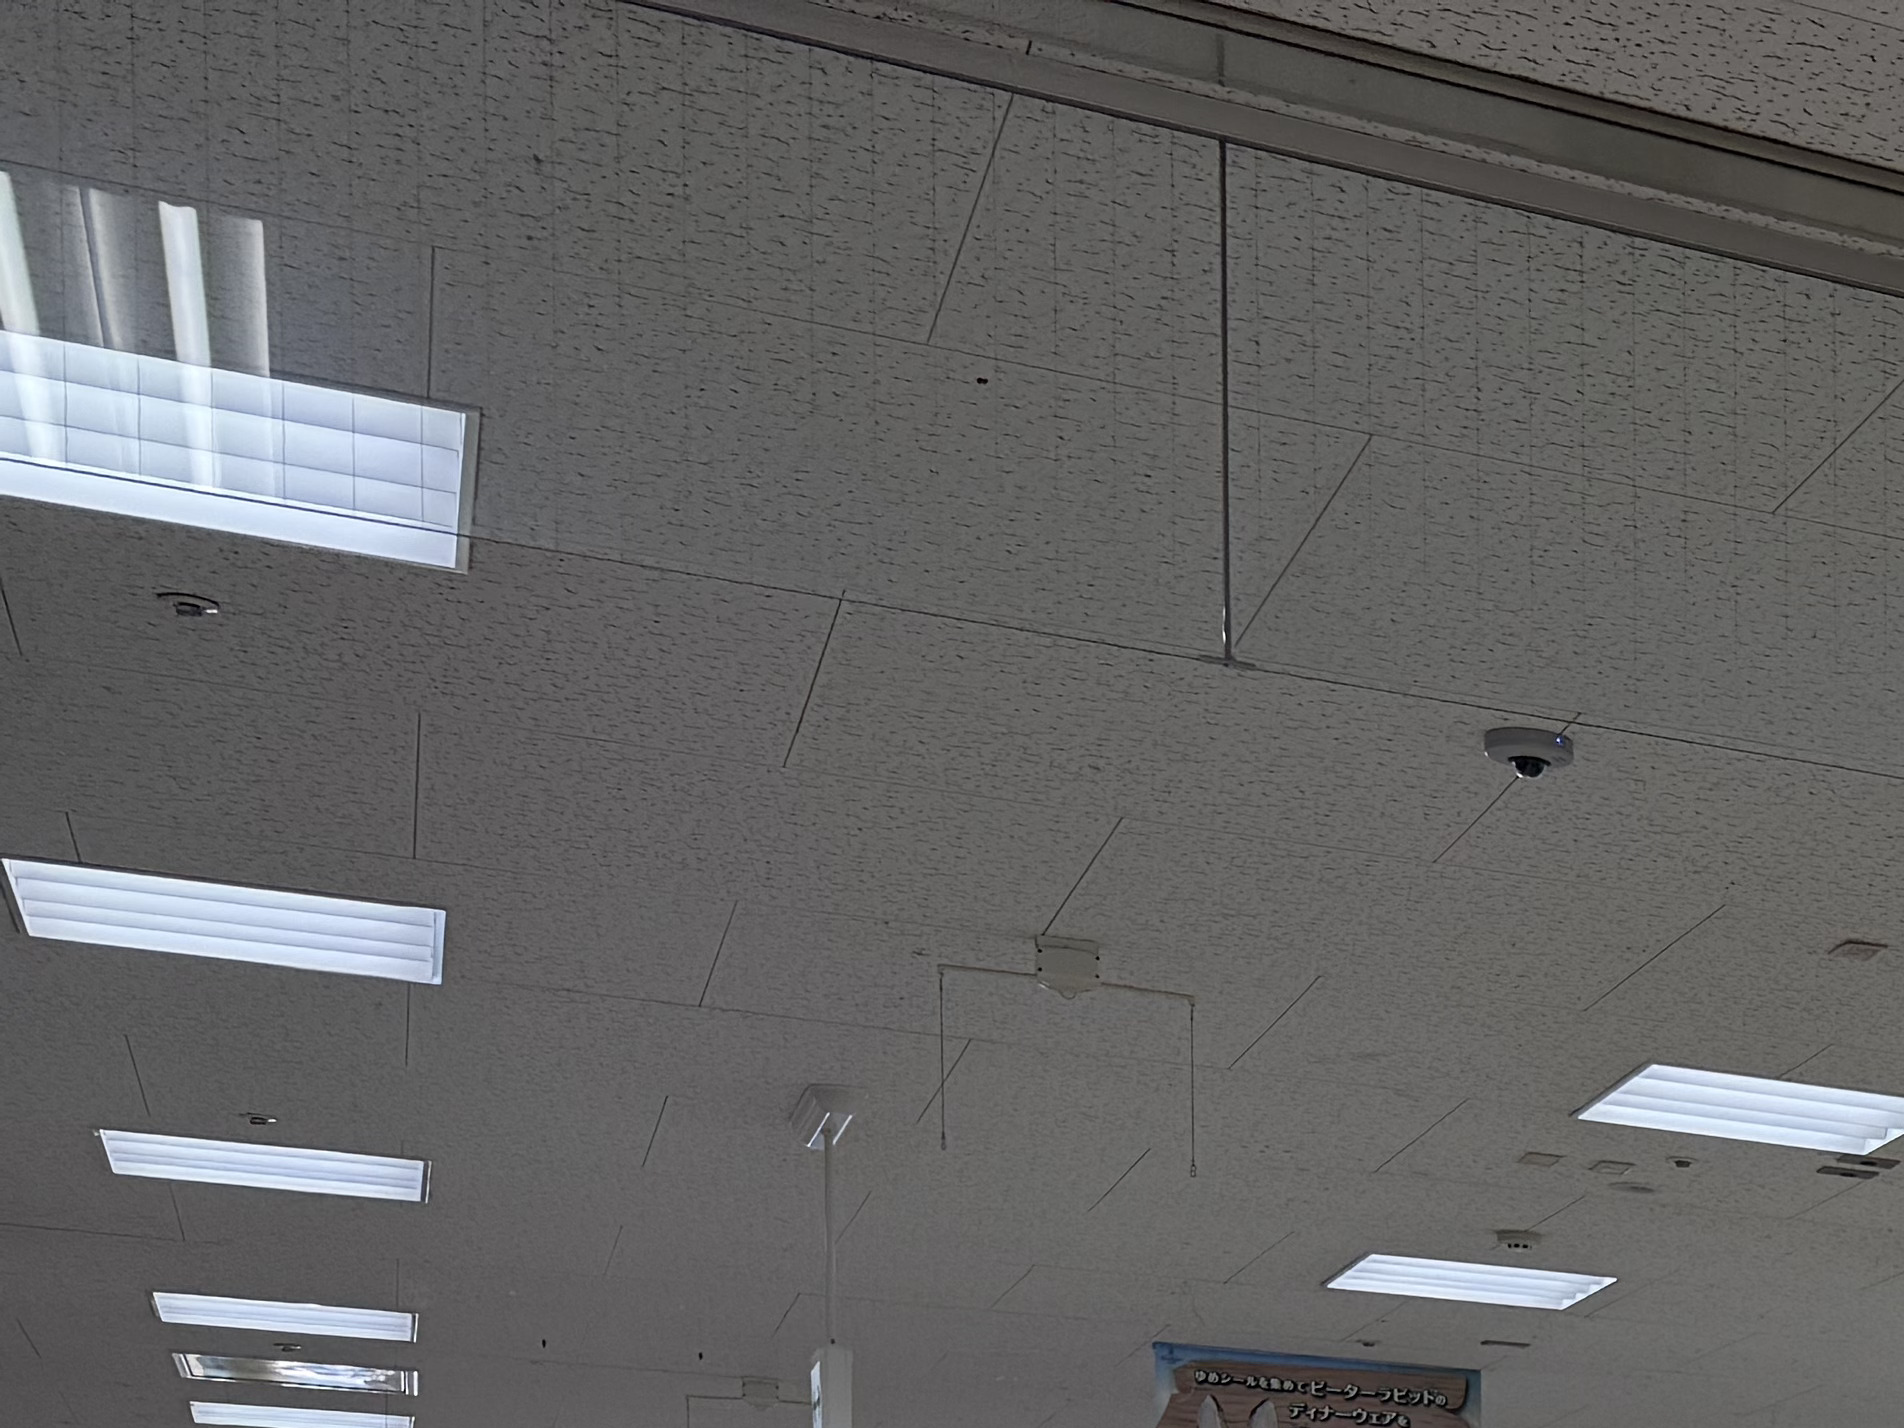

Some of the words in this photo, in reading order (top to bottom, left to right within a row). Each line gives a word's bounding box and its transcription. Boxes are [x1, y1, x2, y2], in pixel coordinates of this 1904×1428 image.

[1288, 1402, 1411, 1428] ディナーウェアを
